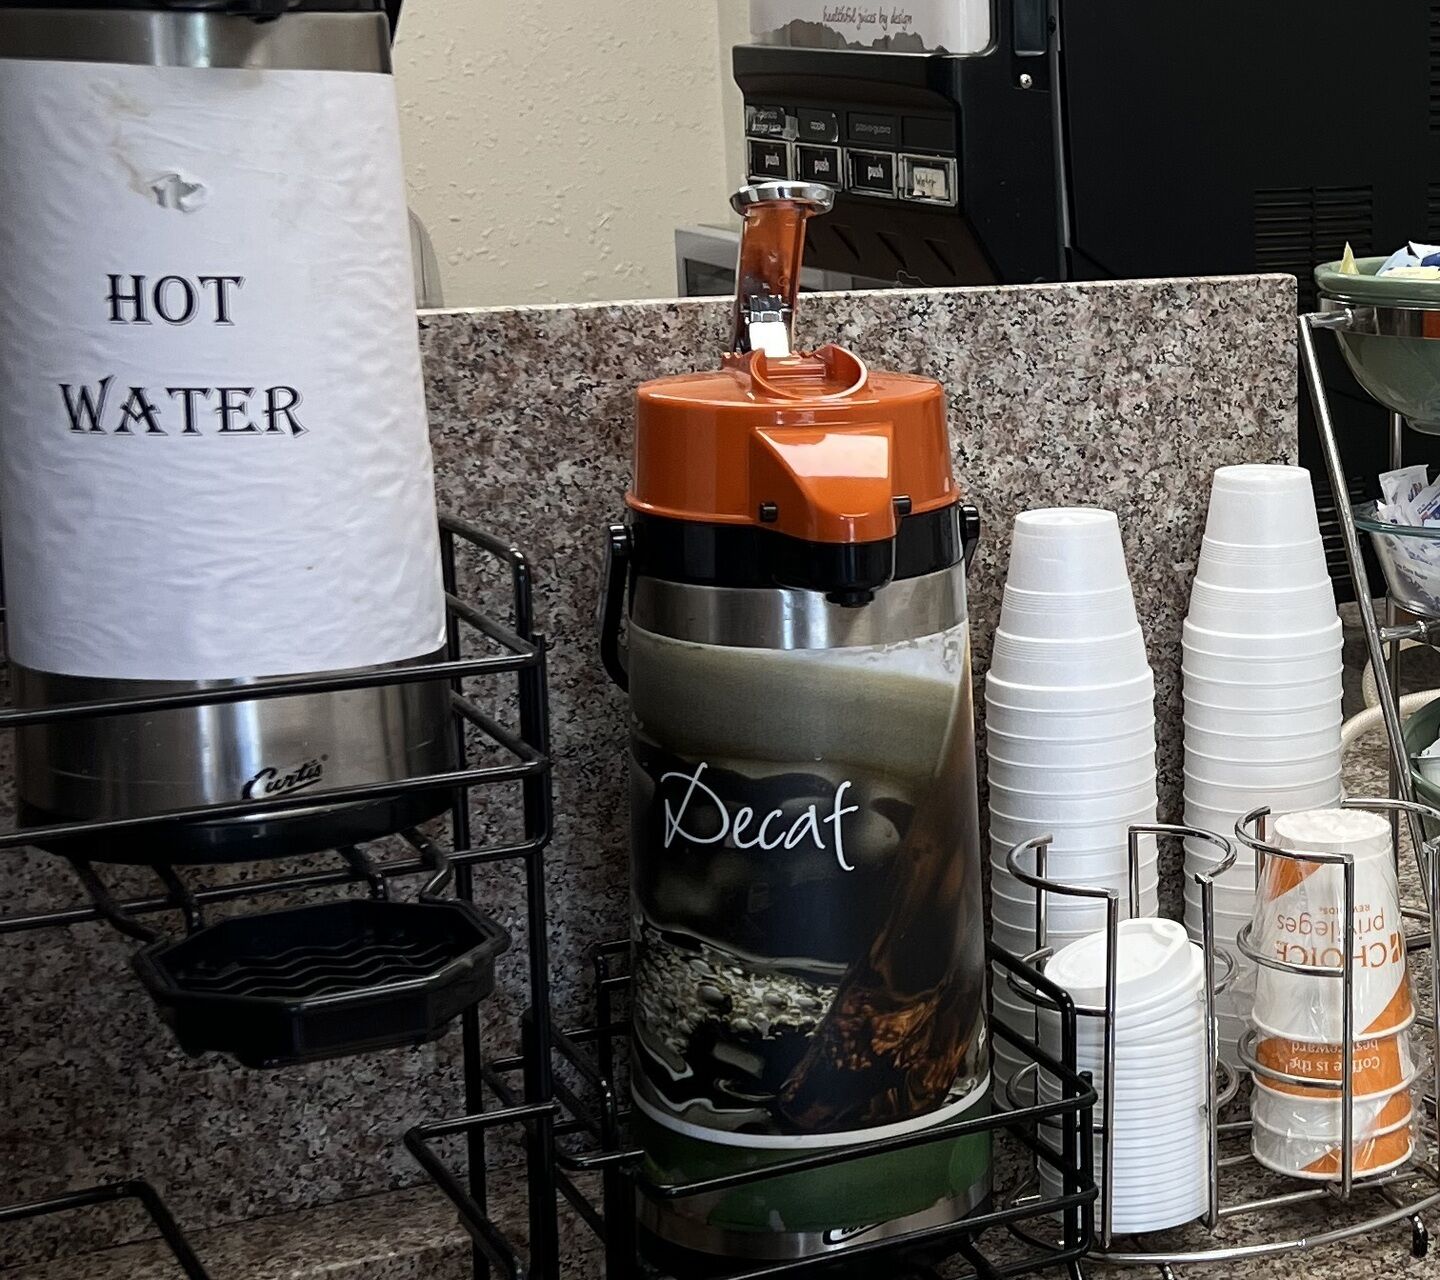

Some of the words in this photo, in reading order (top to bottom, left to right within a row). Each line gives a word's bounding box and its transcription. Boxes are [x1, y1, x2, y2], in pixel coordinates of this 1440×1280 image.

[105, 274, 245, 326] HOT
[59, 375, 309, 439] WATER
[660, 762, 859, 872] Decaf
[1276, 907, 1385, 942] priileges
[1317, 1060, 1328, 1072] is
[1333, 1056, 1381, 1071] Coffe
